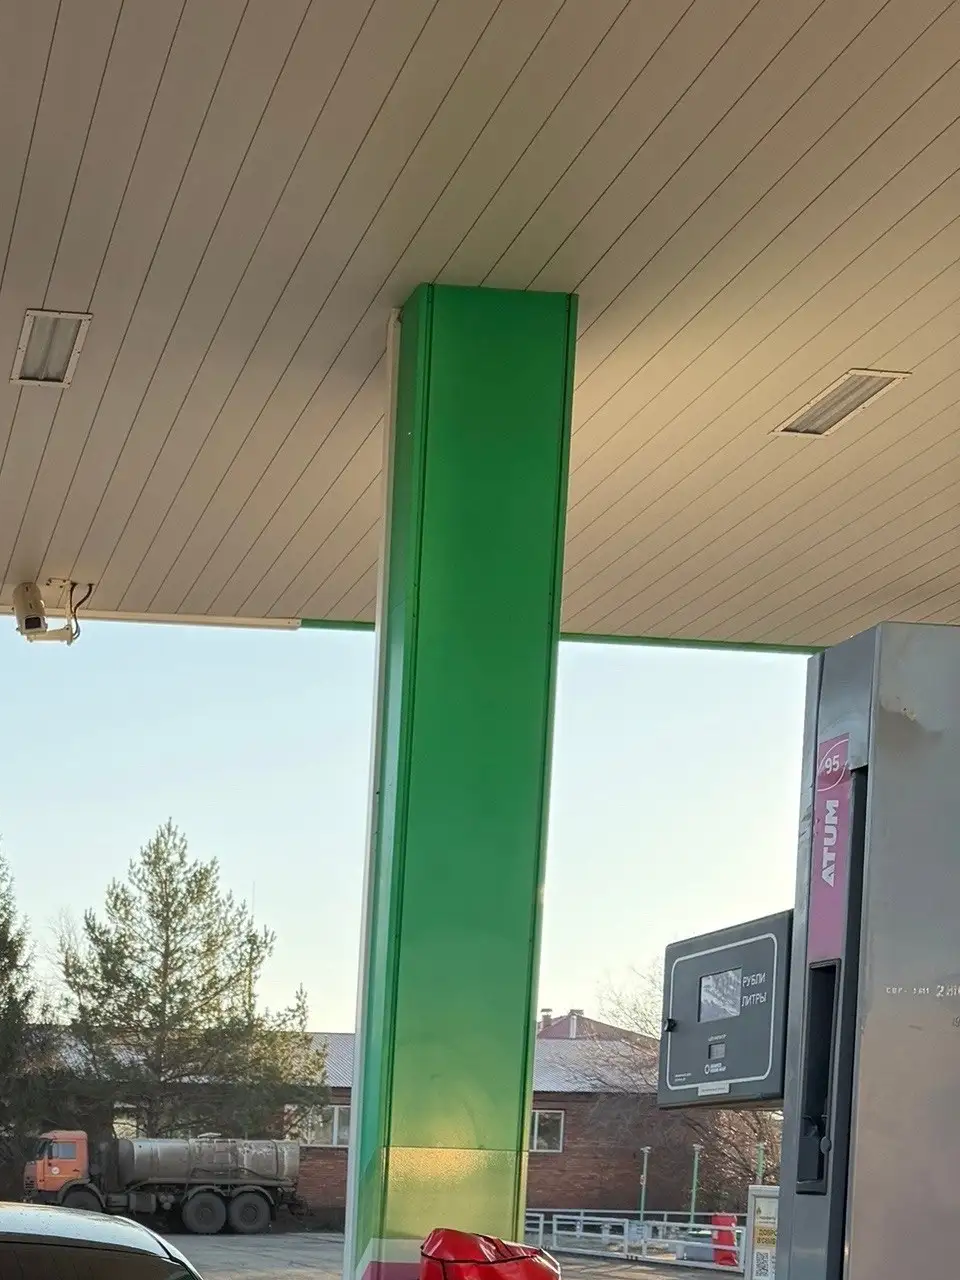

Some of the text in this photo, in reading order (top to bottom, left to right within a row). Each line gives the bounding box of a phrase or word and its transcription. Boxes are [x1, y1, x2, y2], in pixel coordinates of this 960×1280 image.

[821, 800, 840, 888] ATUM
[742, 972, 766, 988] РУБЛИ
[741, 992, 767, 1007] ЛИТРЫ
